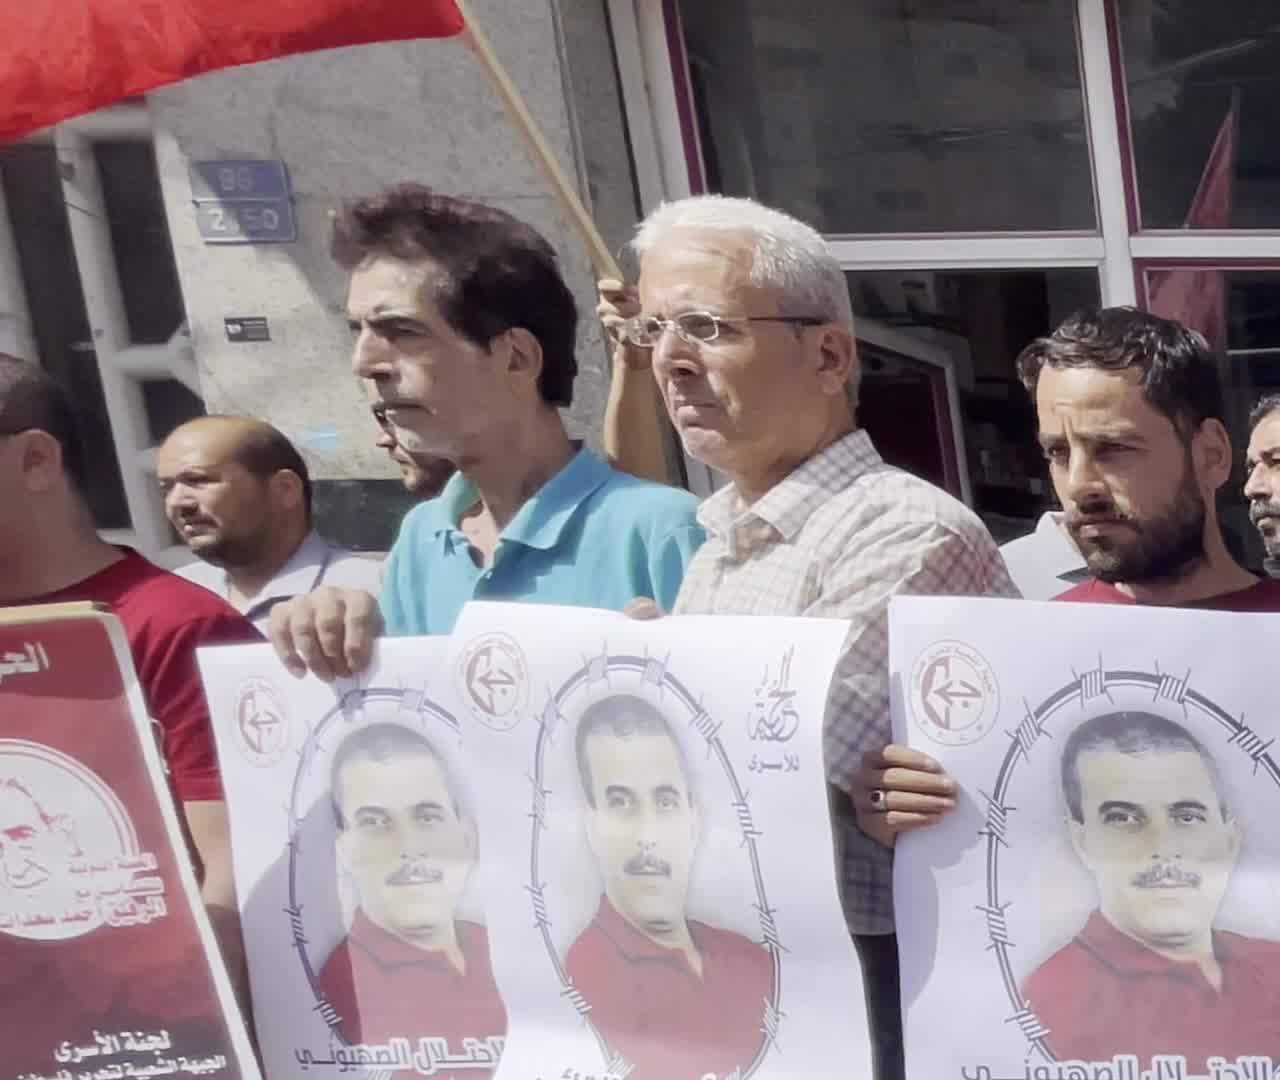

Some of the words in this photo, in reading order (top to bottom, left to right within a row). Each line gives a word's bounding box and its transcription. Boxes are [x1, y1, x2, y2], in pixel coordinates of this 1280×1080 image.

[54, 1028, 121, 1063] الأسرى
[120, 1030, 172, 1055] لجنة
[294, 1039, 409, 1073] الصهيوني
